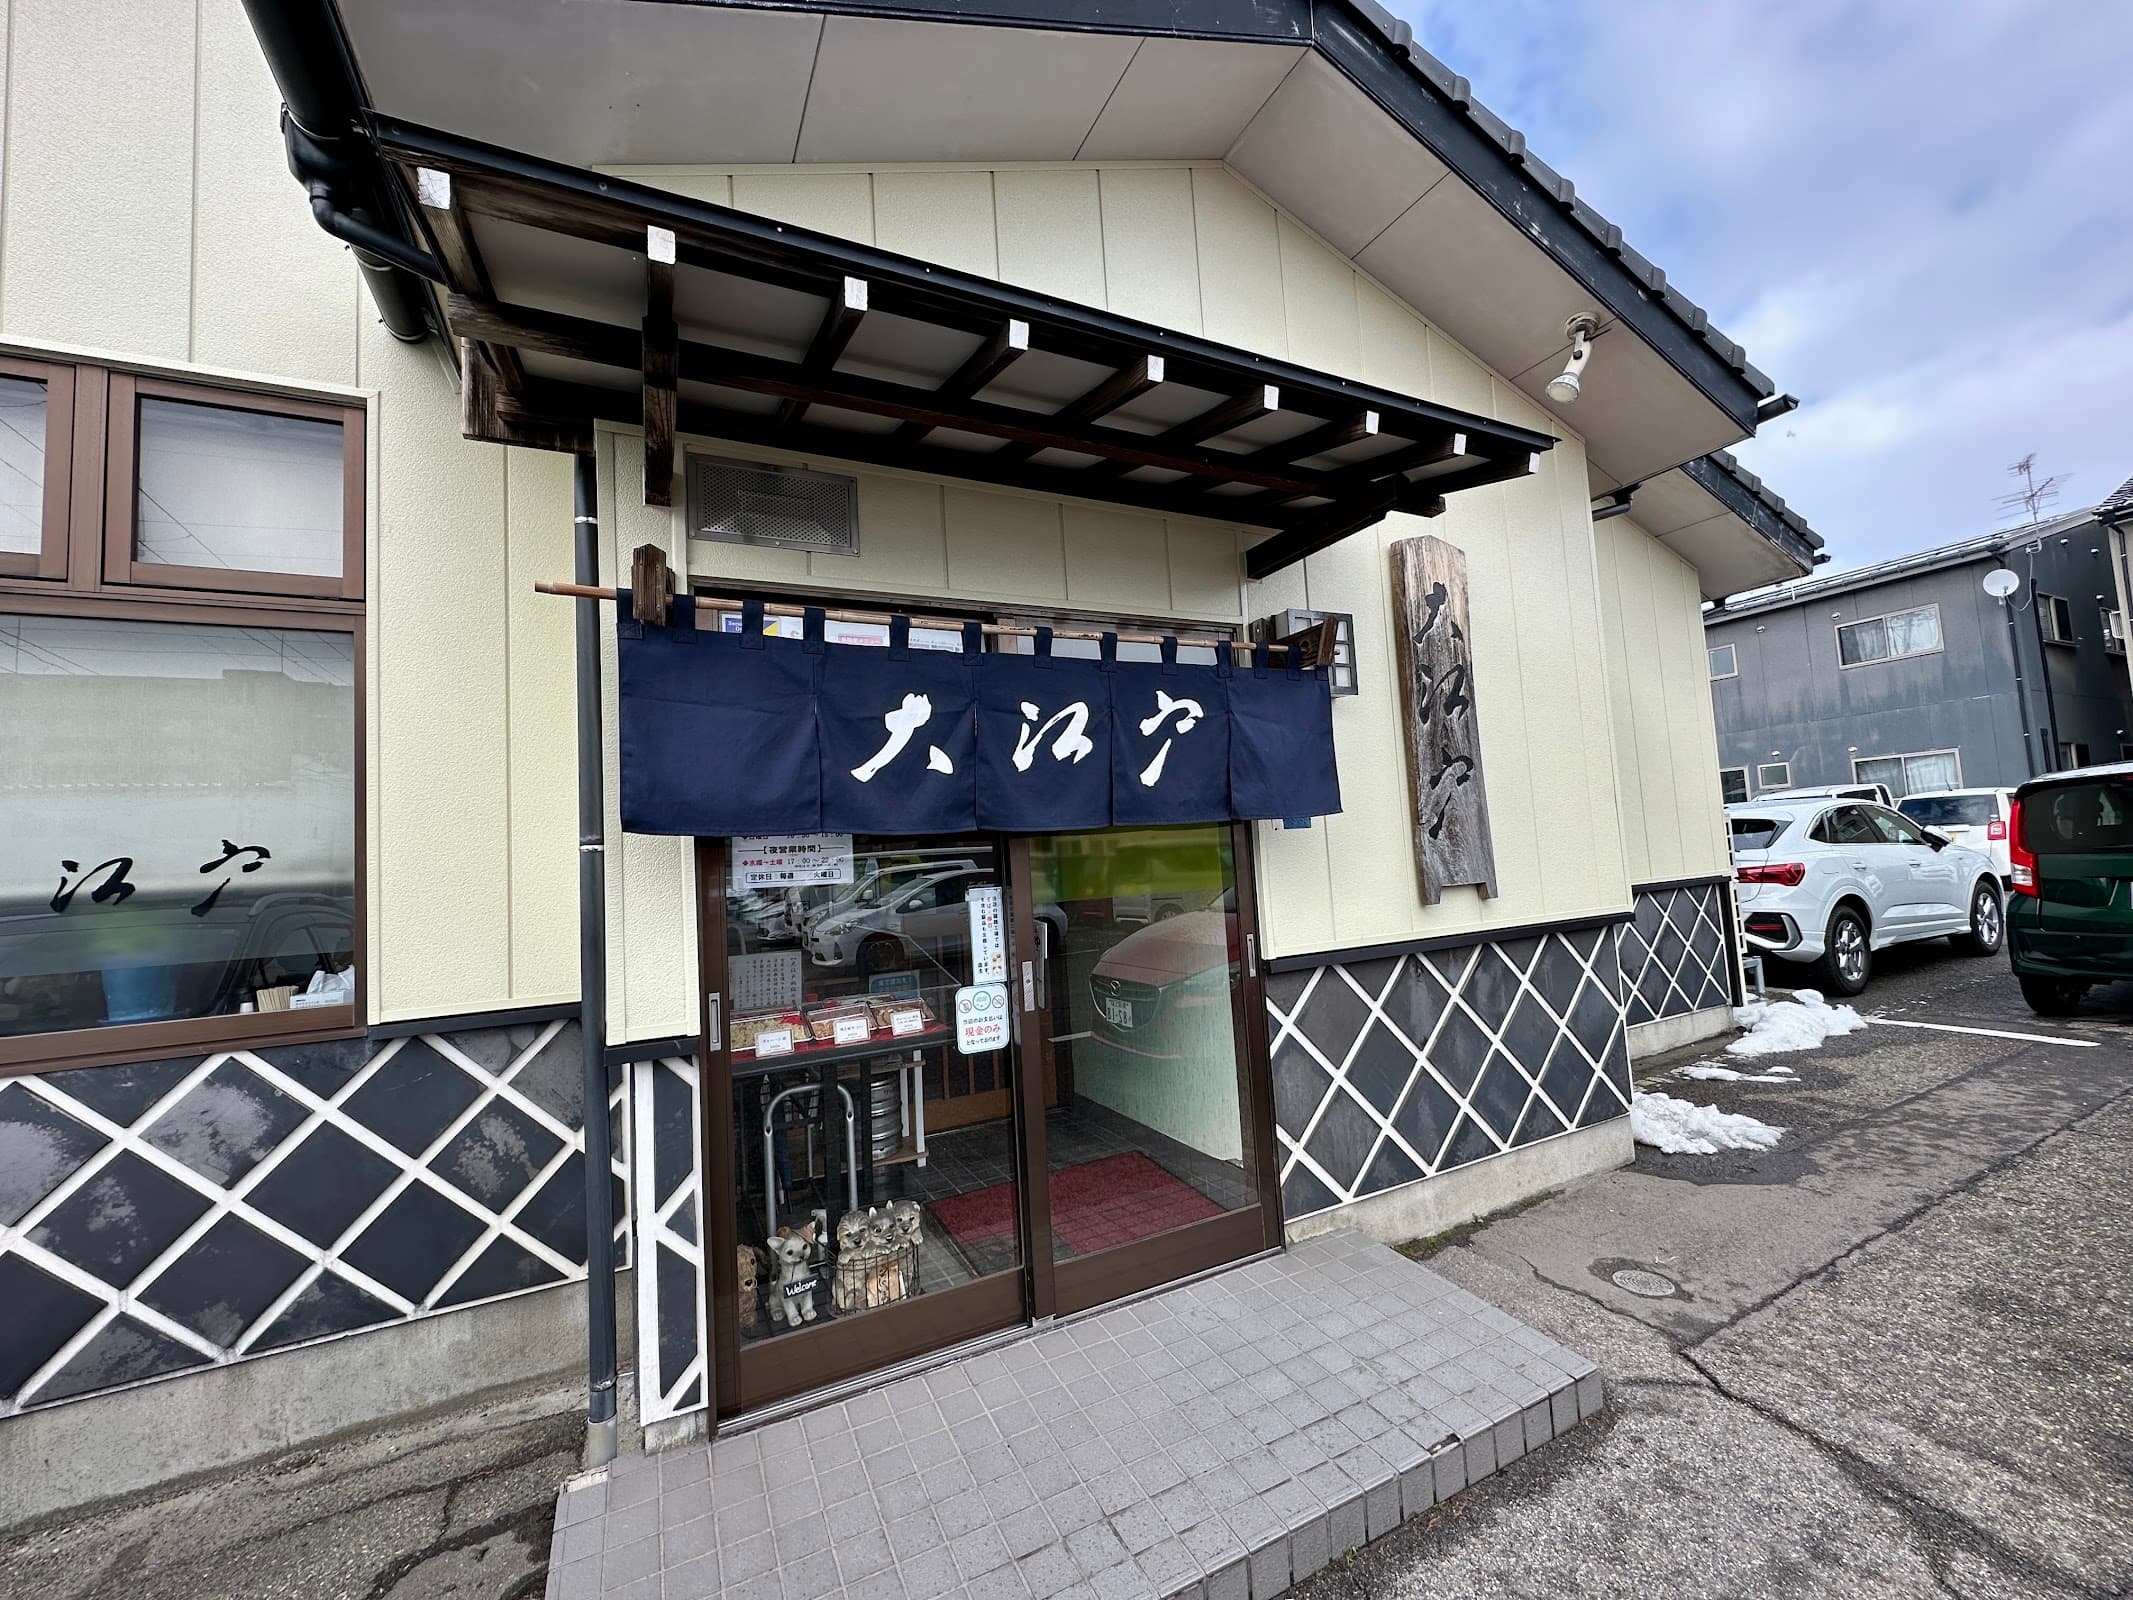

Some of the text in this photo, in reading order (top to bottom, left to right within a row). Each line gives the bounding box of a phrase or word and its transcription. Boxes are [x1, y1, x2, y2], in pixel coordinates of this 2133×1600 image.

[850, 688, 1204, 788] 大江戸
[965, 1024, 1001, 1037] 現金のみ
